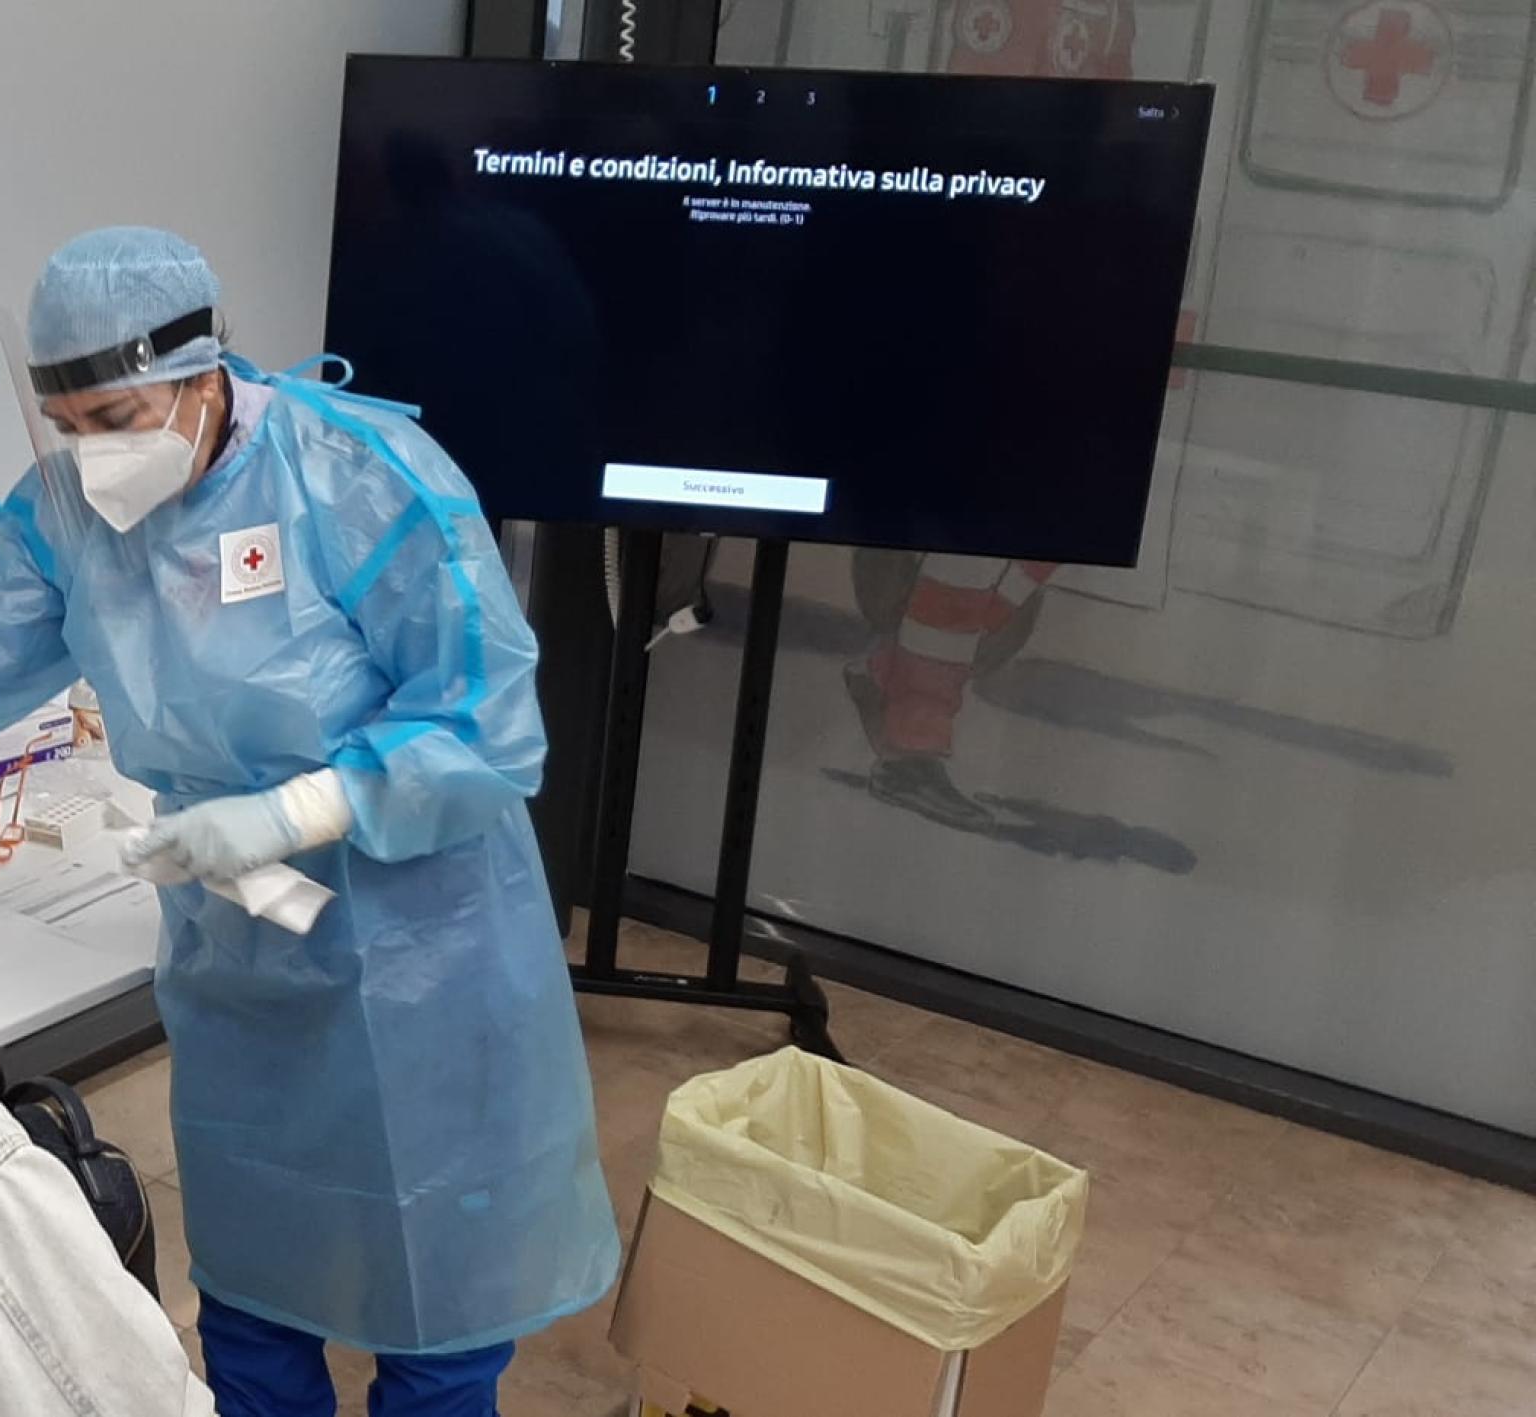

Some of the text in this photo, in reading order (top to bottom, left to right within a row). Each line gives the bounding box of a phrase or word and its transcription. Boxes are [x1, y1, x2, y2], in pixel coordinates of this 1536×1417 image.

[708, 85, 816, 105] 1 2 3
[474, 149, 1045, 202] Termini e condizioni, Informativa sulla privacy
[691, 197, 722, 208] server
[689, 208, 736, 221] Riprovare
